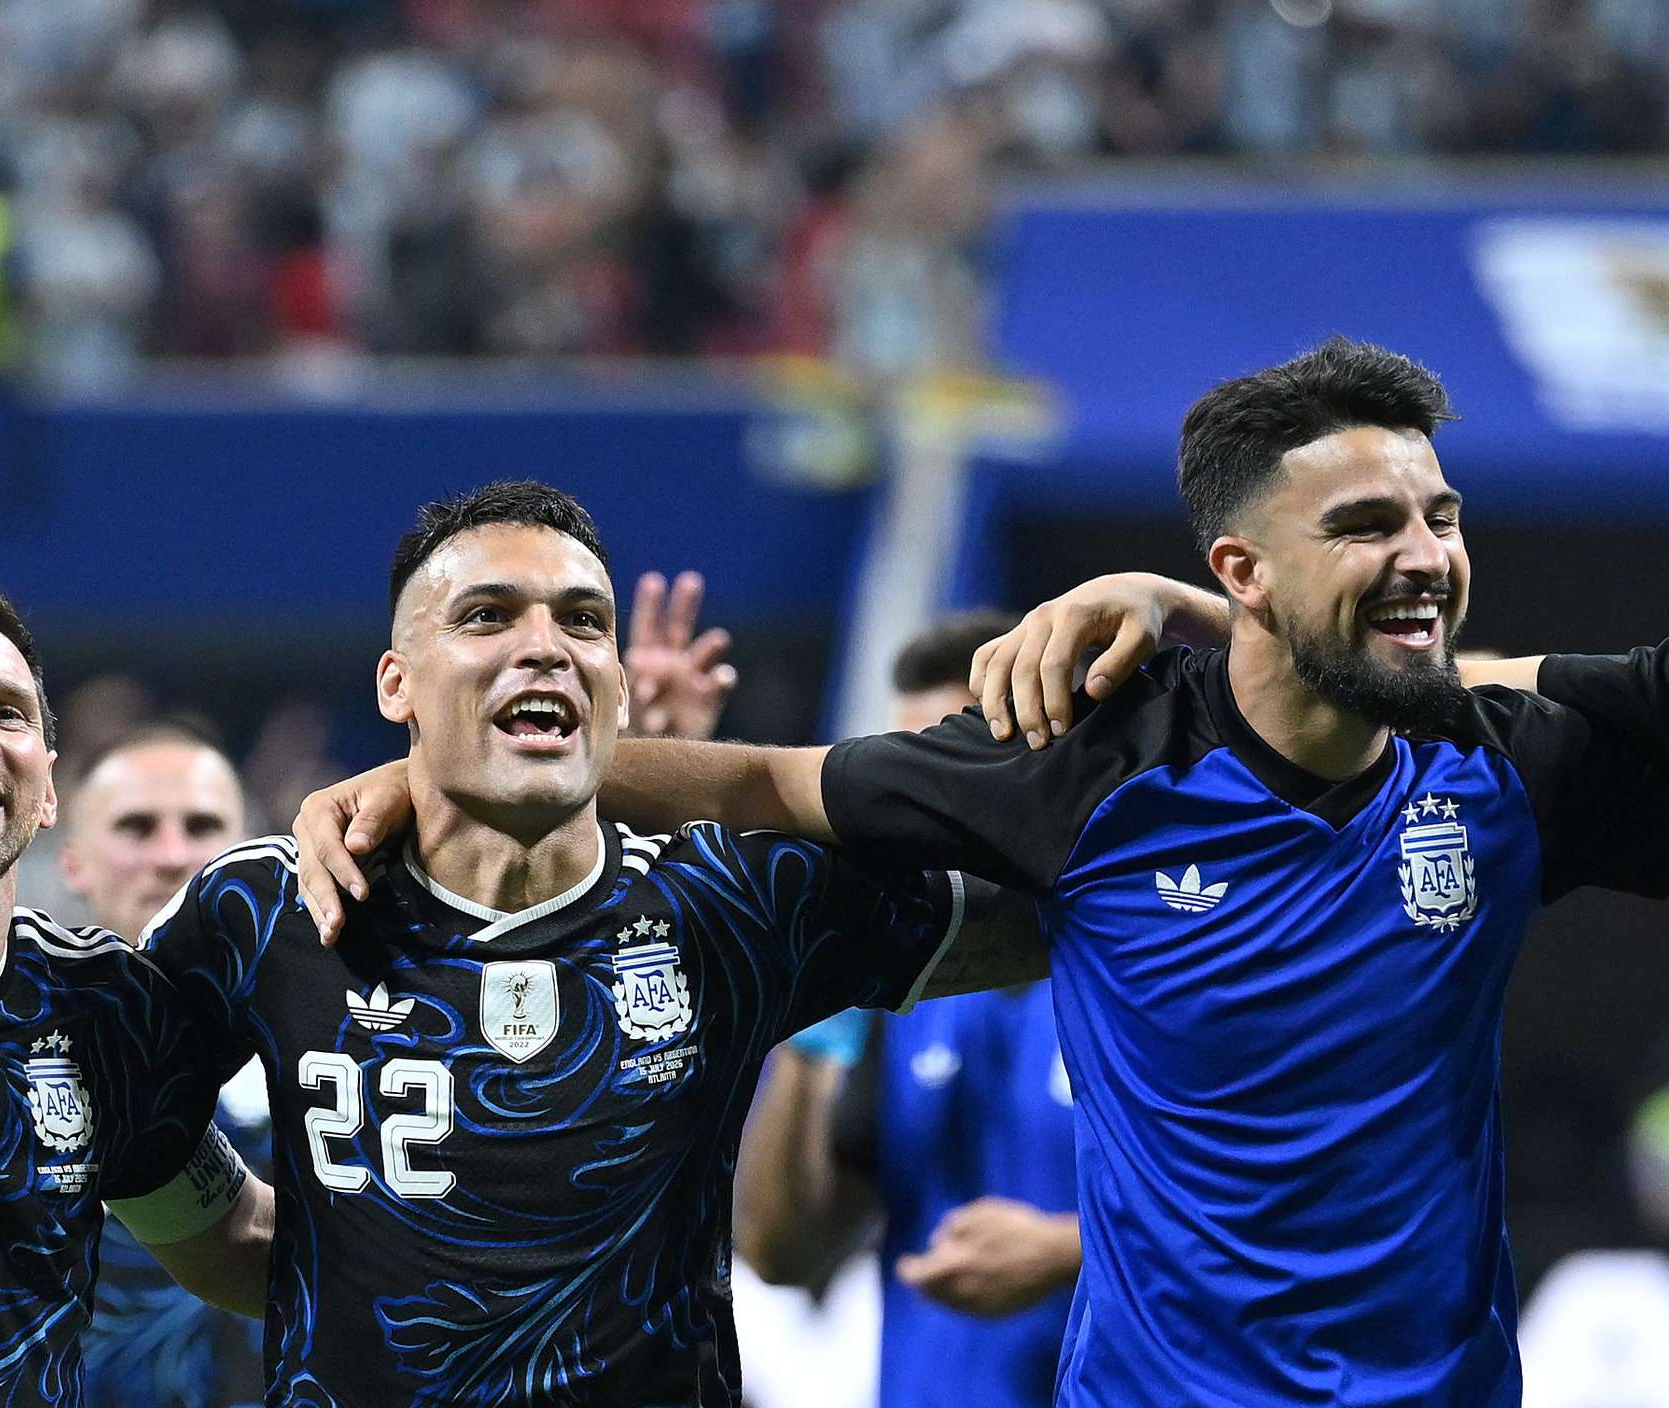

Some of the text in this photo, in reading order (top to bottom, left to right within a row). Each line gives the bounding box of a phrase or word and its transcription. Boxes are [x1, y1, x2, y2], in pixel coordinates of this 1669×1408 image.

[1419, 854, 1461, 898] AFA
[633, 970, 675, 1012] AFA
[503, 1025, 536, 1035] FIFA
[620, 1055, 652, 1070] ENGLAND
[653, 1053, 663, 1063] VS
[639, 1059, 683, 1075] 15 JULY 2026
[45, 1081, 81, 1123] AFA
[298, 1050, 457, 1199] 22
